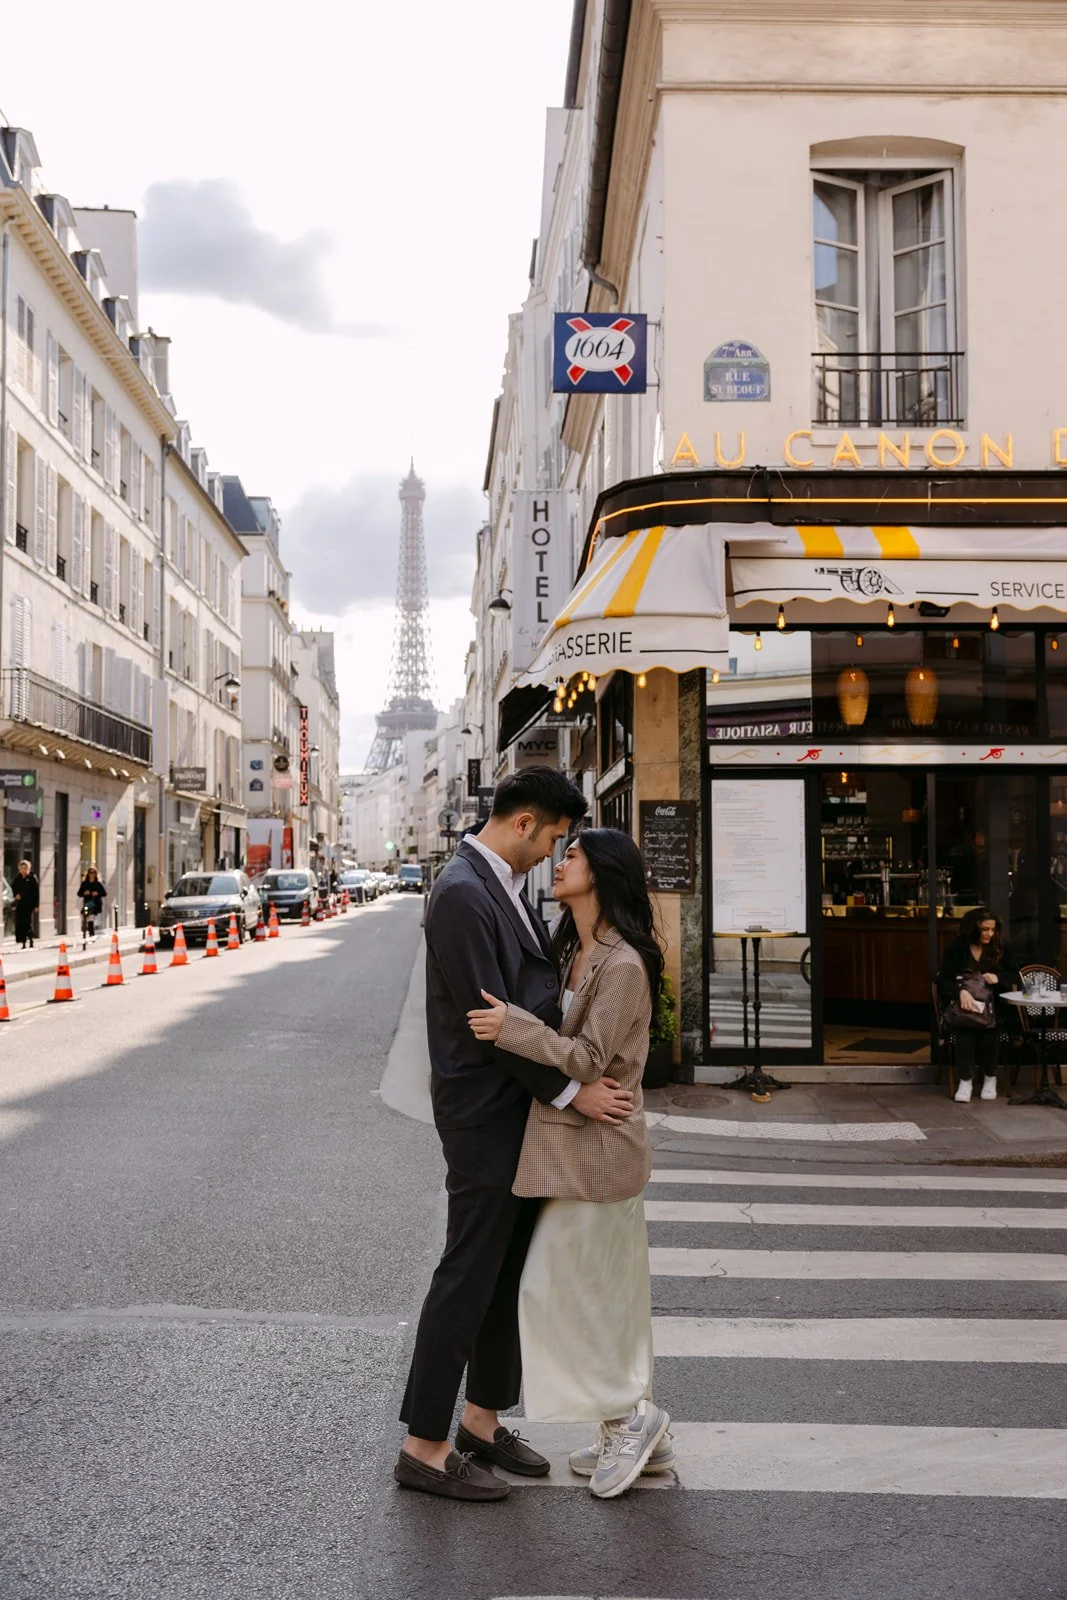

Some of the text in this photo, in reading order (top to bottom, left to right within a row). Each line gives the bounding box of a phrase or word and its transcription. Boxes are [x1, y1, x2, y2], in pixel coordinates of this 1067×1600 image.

[573, 334, 627, 360] 1664
[724, 371, 751, 382] RUE
[710, 384, 765, 395] SURCOUF
[670, 430, 746, 469] AU
[783, 429, 1014, 470] CANON
[531, 500, 551, 623] HOTEL
[990, 581, 1065, 599] SERVICE
[547, 631, 633, 666] ASSERIE
[299, 706, 308, 805] THOUMIEUX
[517, 741, 557, 751] MYC
[618, 1437, 640, 1457] N
